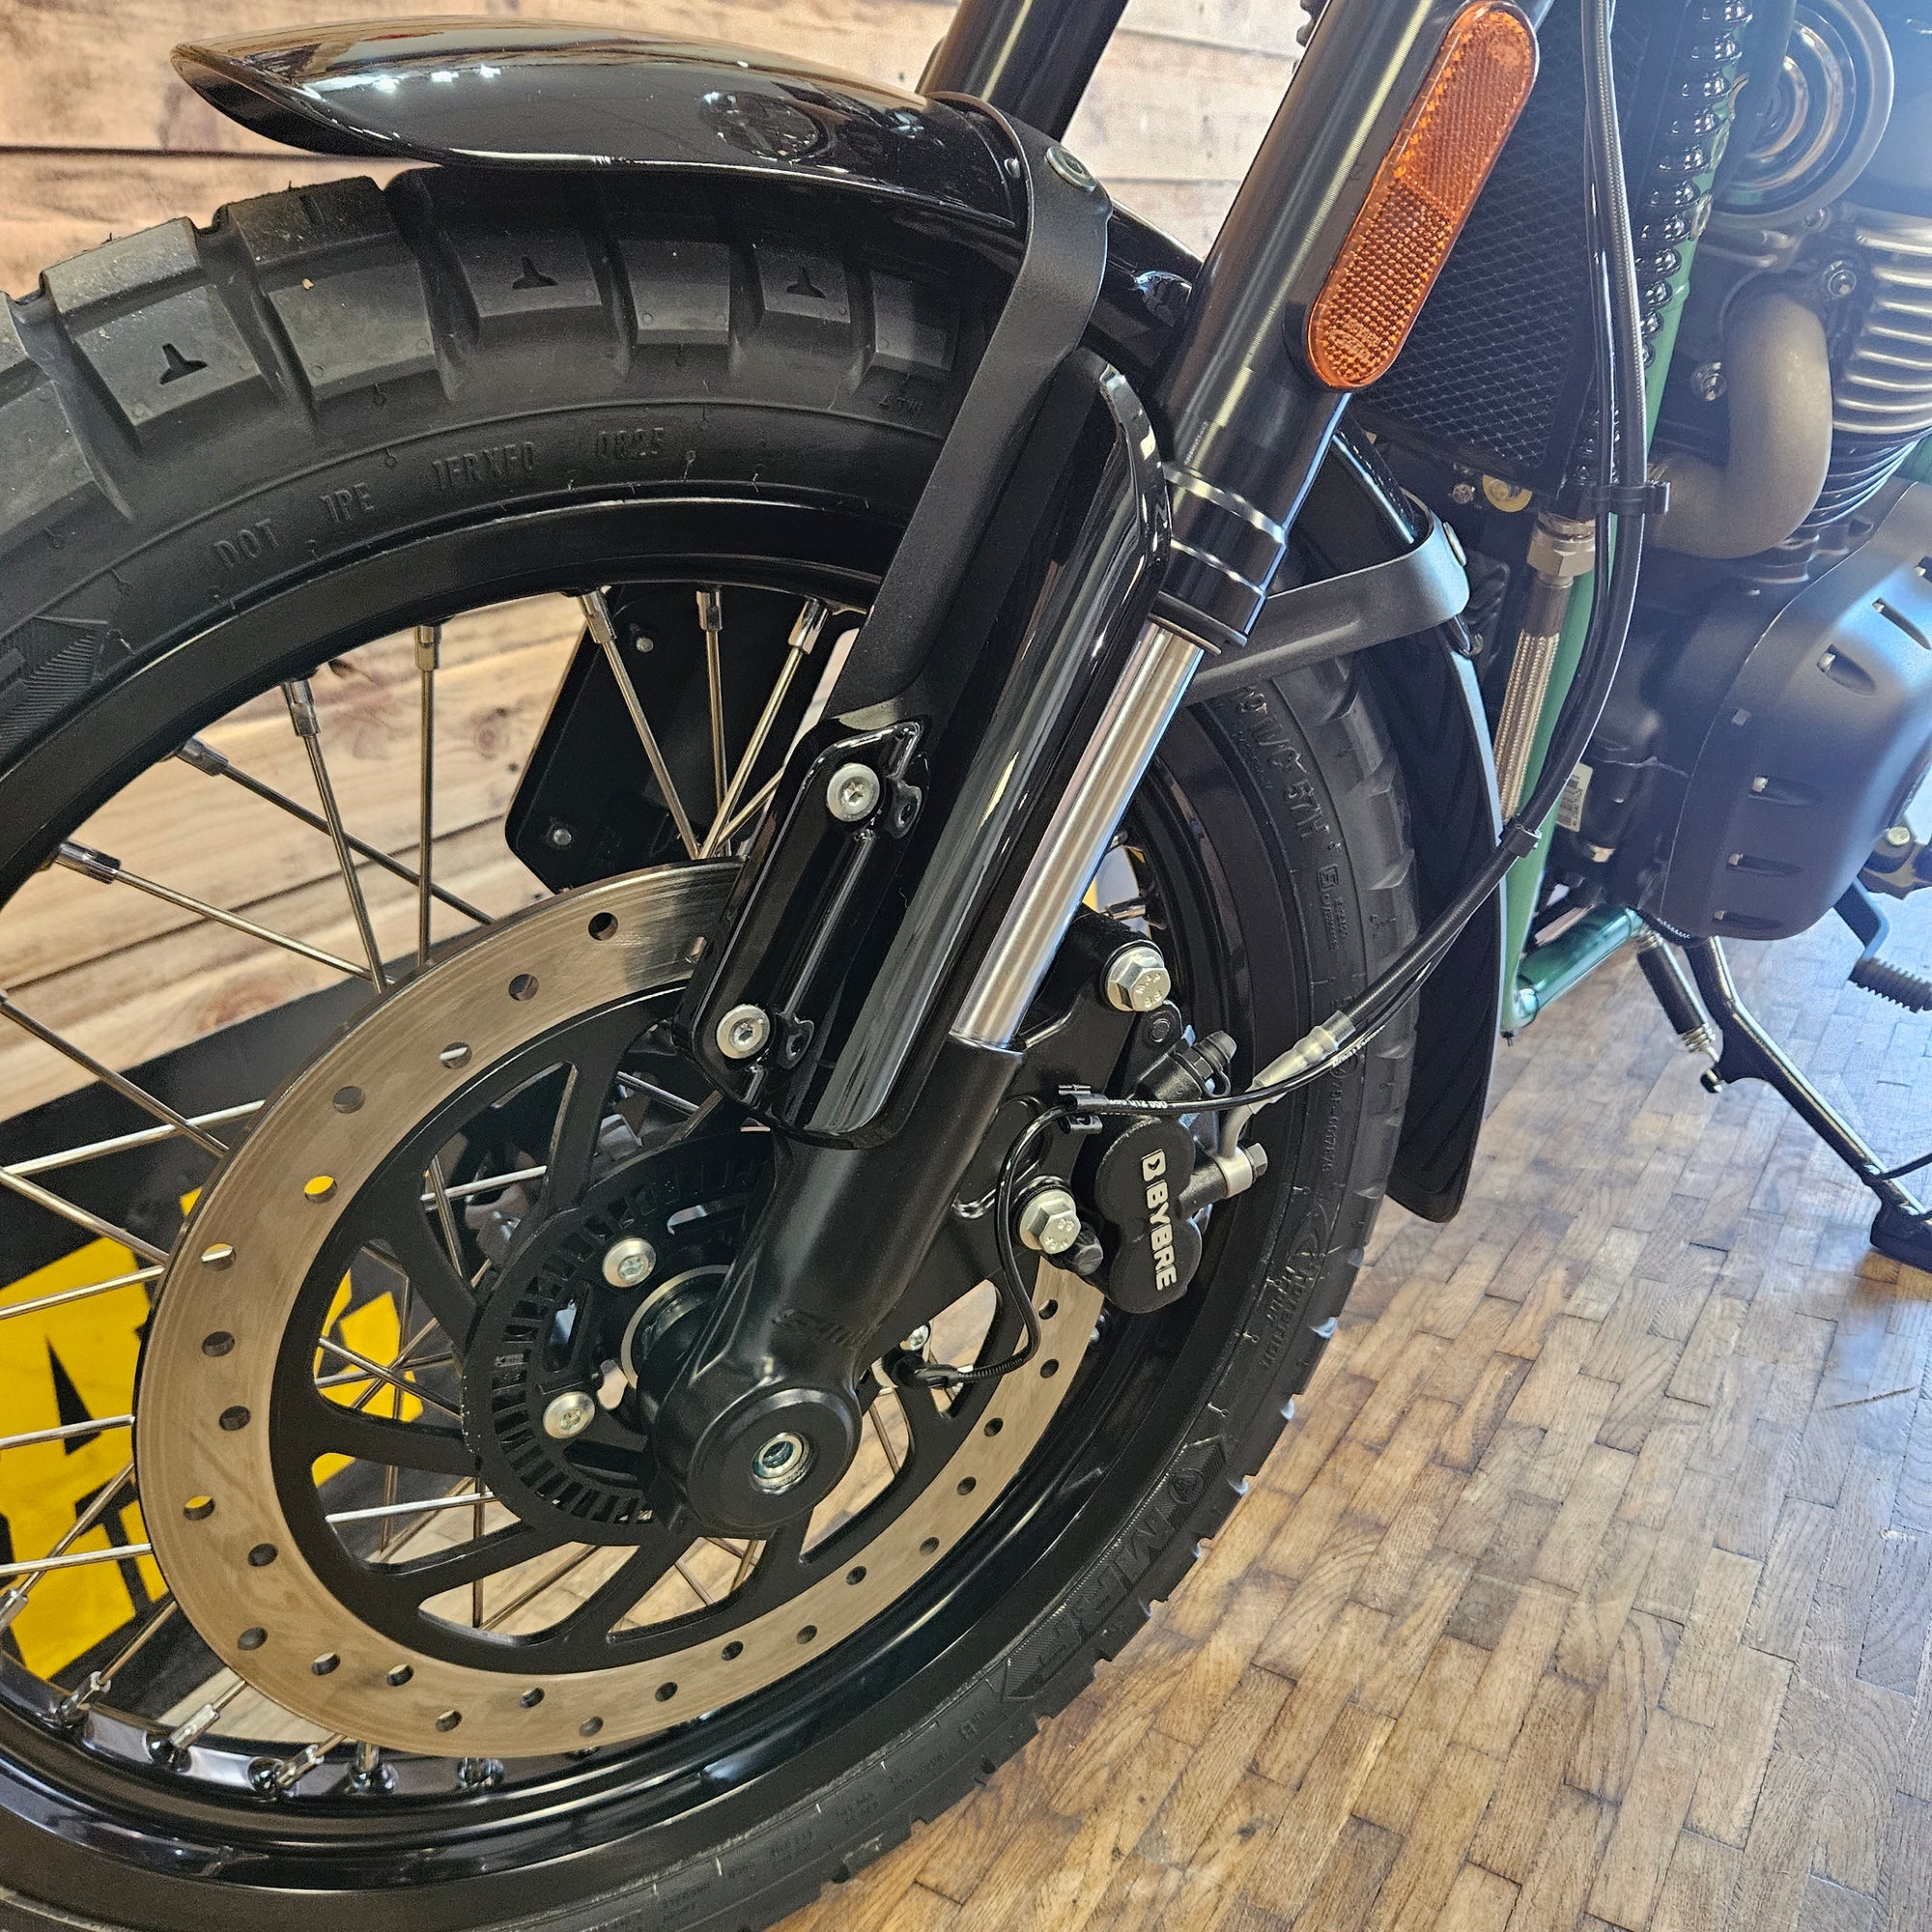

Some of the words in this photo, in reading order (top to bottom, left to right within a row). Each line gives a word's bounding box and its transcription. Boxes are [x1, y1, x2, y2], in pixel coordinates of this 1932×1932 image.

[211, 519, 284, 570] DOT
[319, 481, 378, 526] 1PE
[1144, 1179, 1178, 1292] BYBRE
